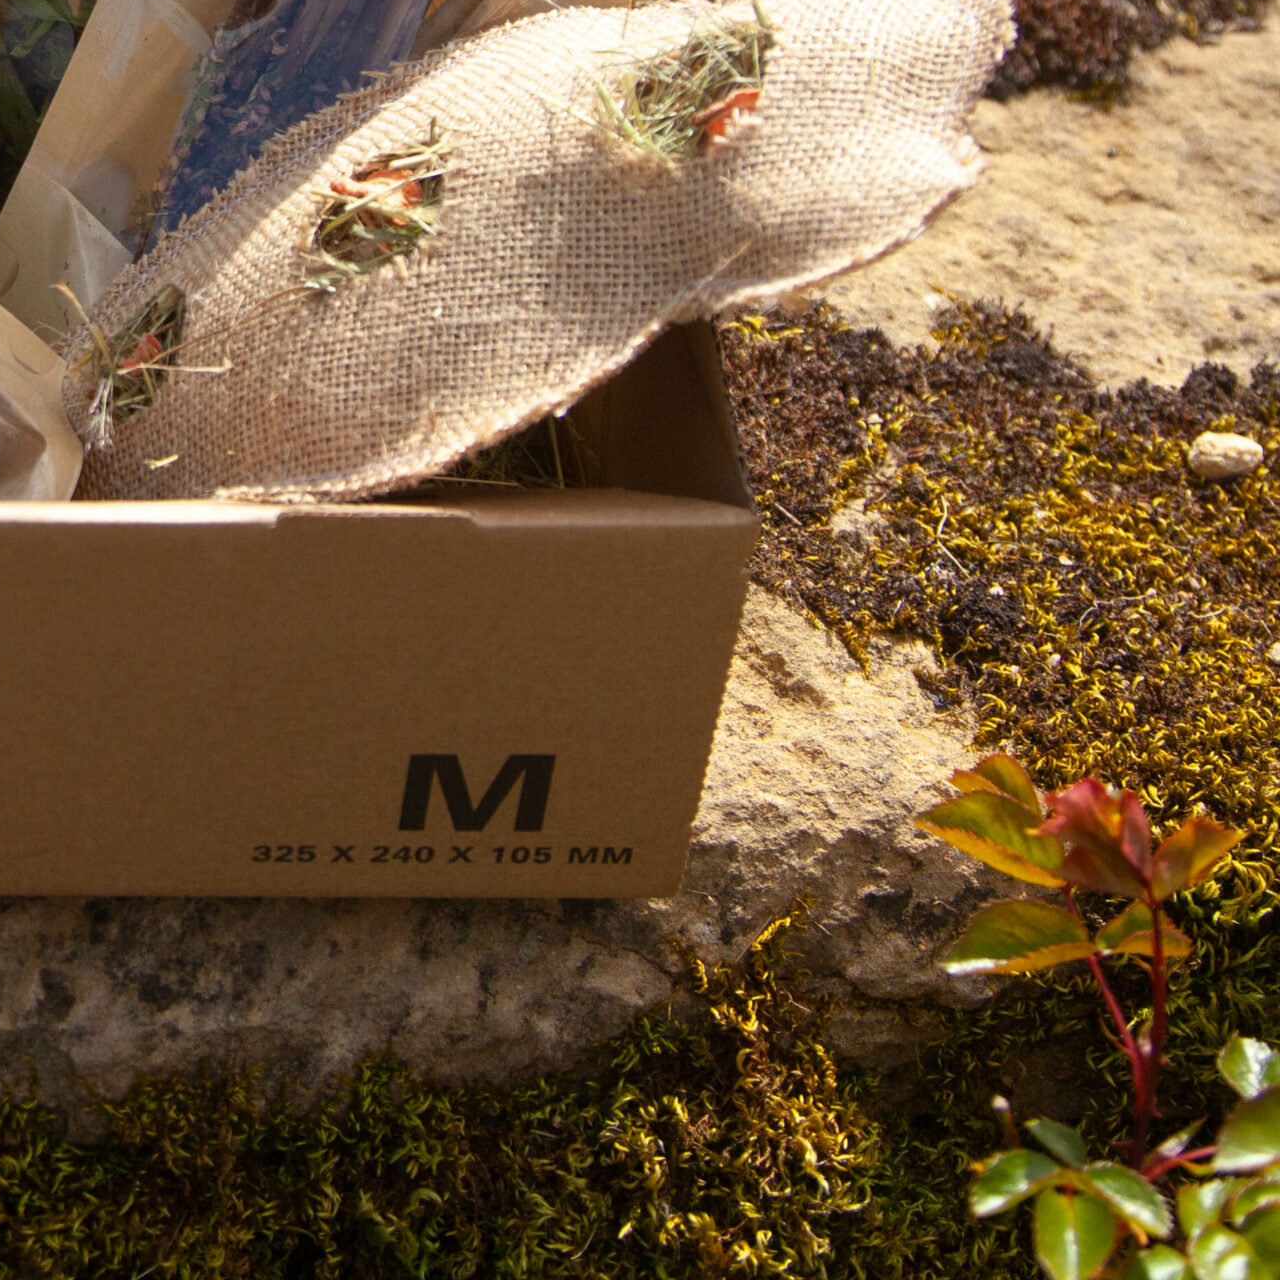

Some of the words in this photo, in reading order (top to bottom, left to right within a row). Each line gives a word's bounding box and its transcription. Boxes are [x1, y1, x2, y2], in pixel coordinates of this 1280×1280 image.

[398, 753, 557, 832] M
[251, 844, 317, 864] 325
[330, 845, 356, 863] X
[370, 845, 435, 864] 240
[448, 846, 473, 864] X
[493, 846, 552, 864] 105
[567, 846, 634, 865] MM
